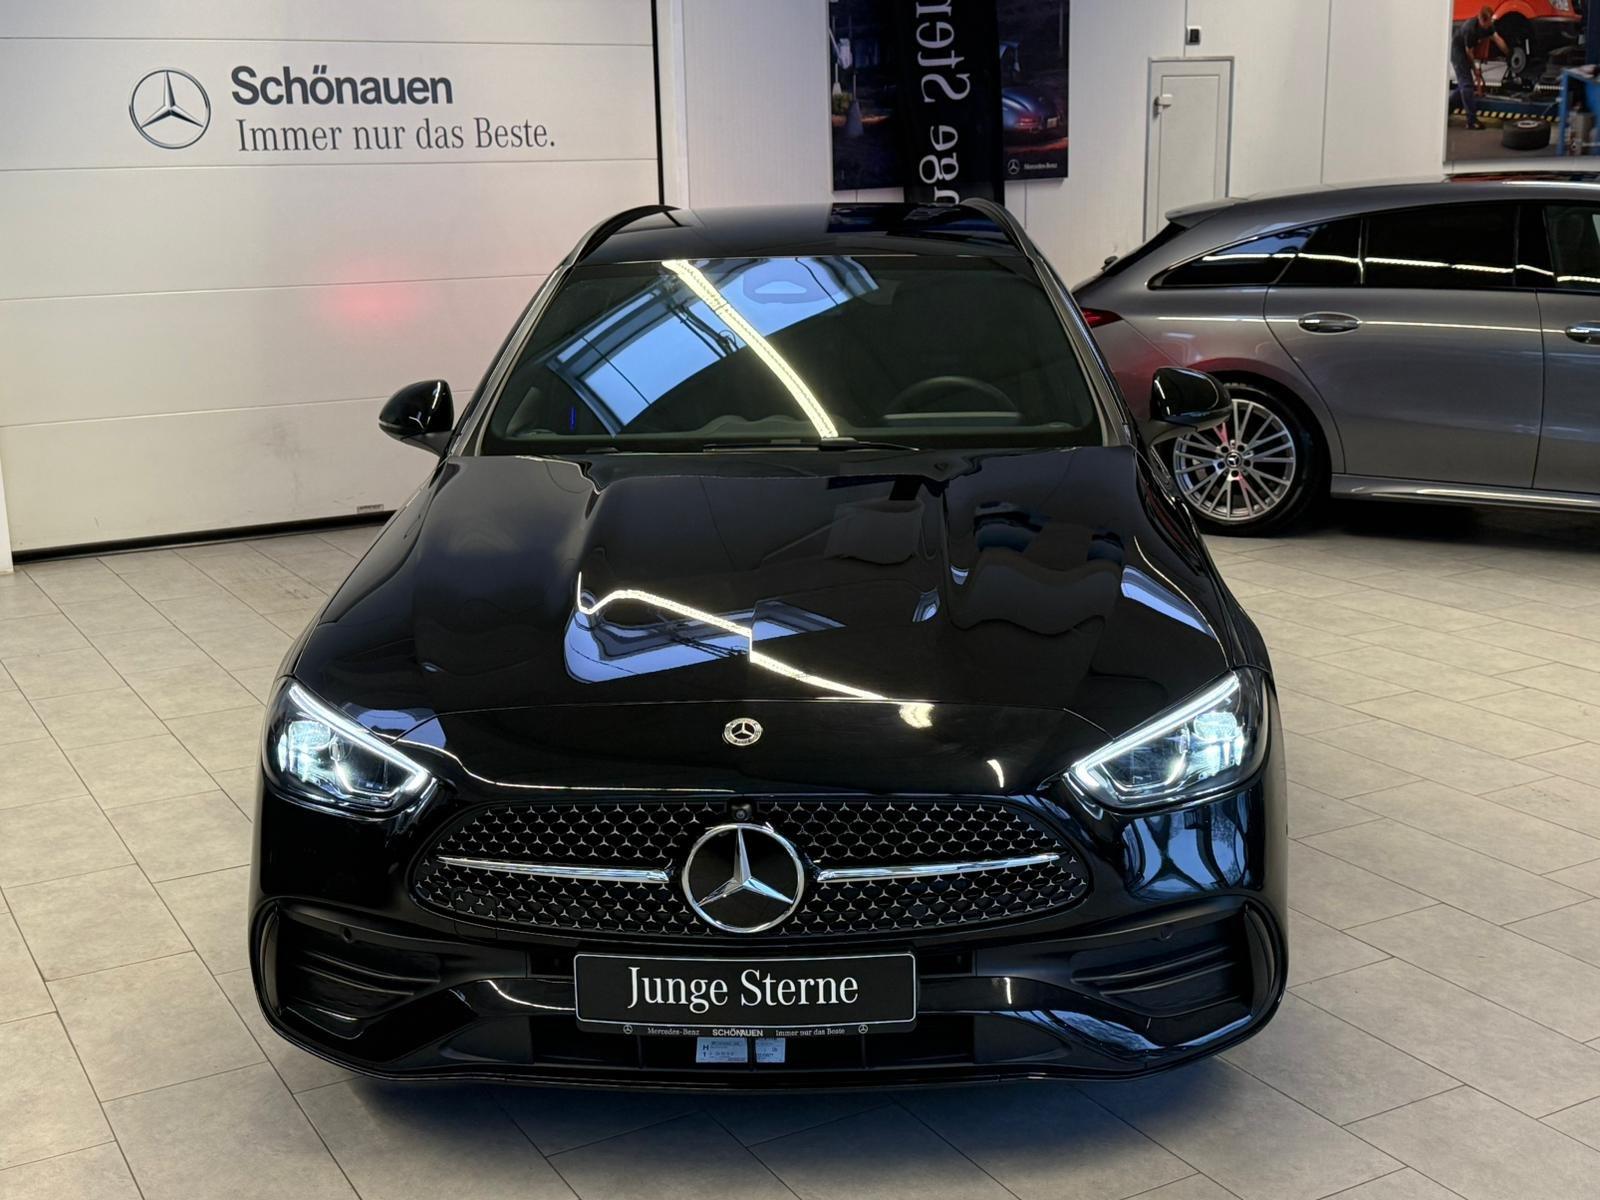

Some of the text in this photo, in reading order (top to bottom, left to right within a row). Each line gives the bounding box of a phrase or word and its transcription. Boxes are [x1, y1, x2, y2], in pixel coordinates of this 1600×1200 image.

[231, 65, 453, 106] Schönauen
[236, 117, 555, 152] Immer nur das Beste.
[627, 966, 859, 1014] Junge Sterne
[647, 1027, 700, 1036] Mercedes-Benz
[813, 1028, 825, 1036] das
